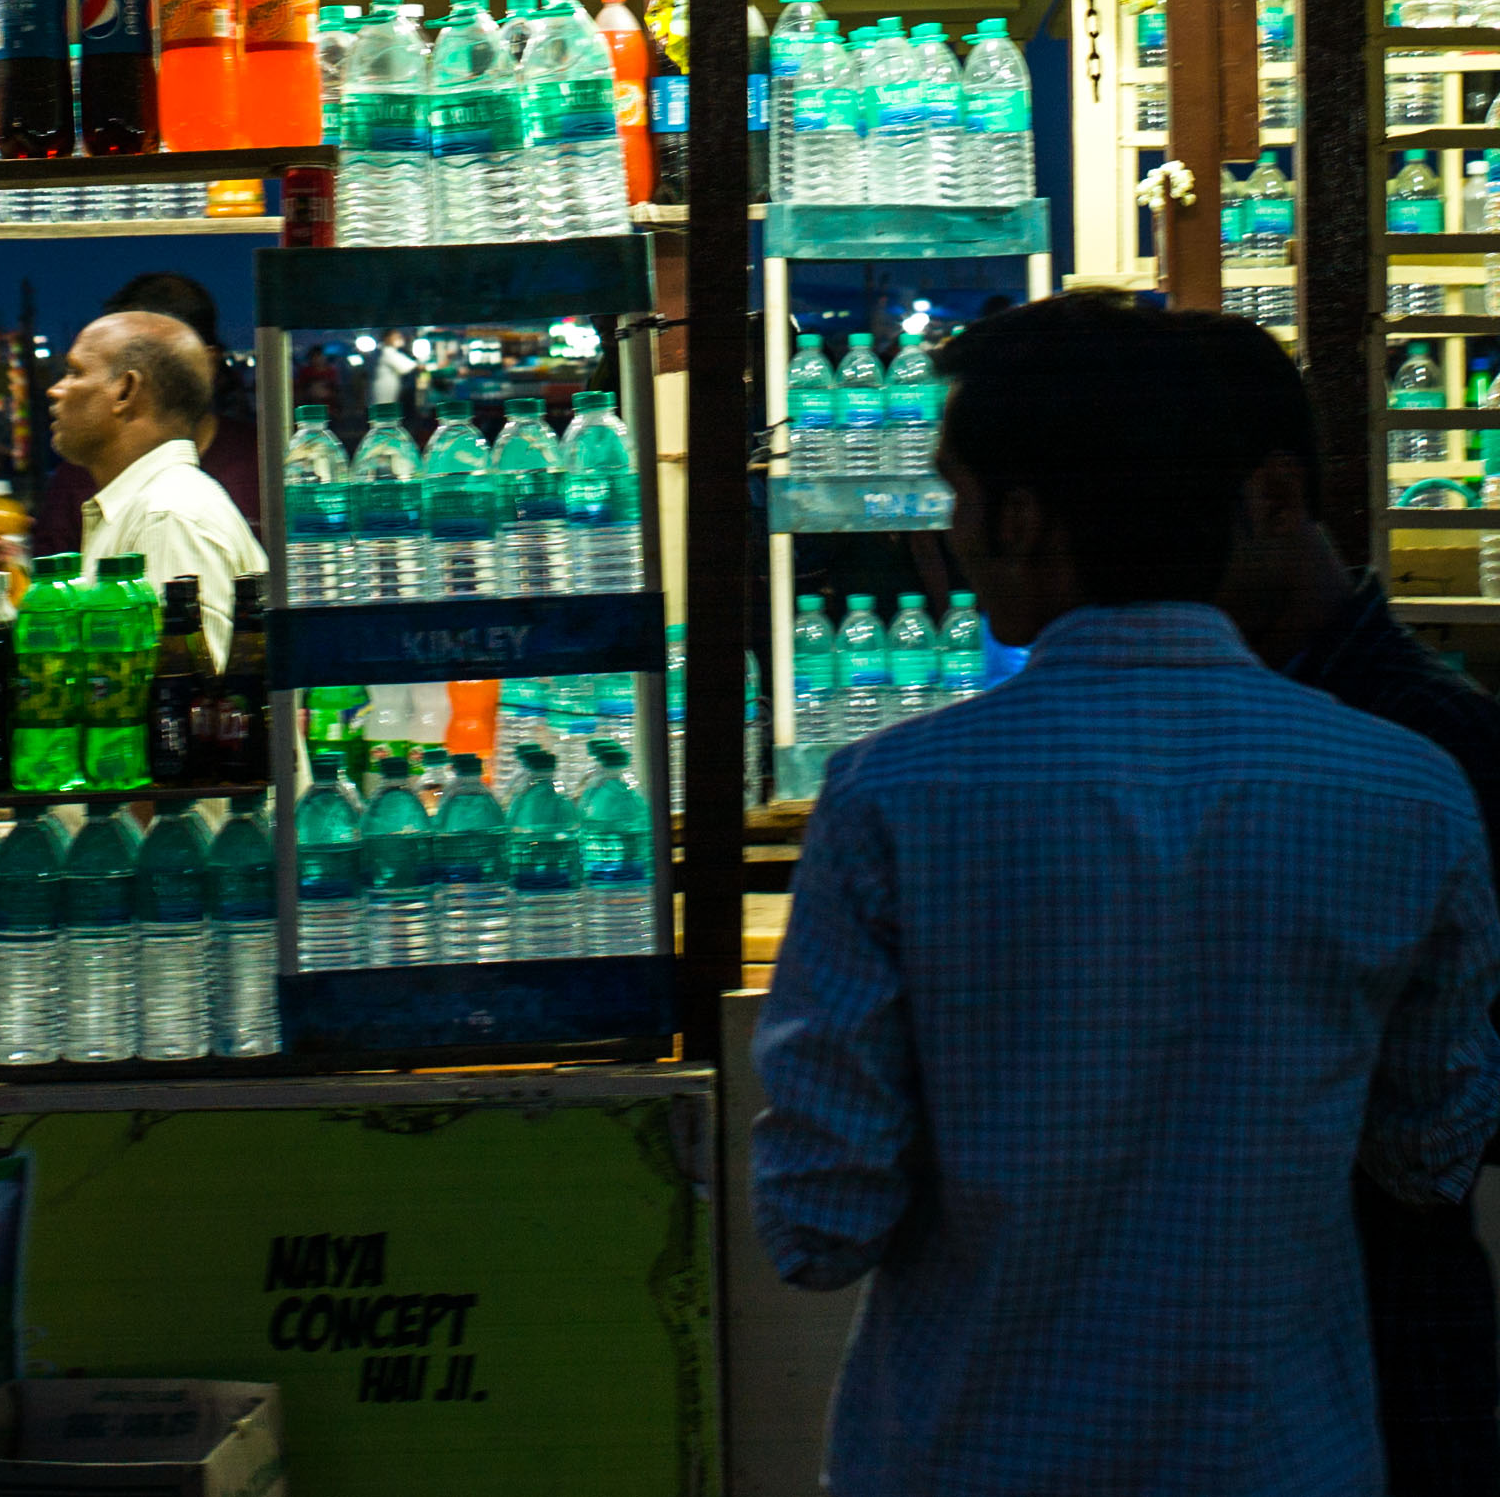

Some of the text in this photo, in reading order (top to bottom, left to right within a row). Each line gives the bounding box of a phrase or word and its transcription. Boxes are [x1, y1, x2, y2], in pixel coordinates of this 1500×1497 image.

[264, 1233, 389, 1292] NAYA
[269, 1292, 479, 1353] CONCEPT
[359, 1354, 489, 1404] HAI JI.
